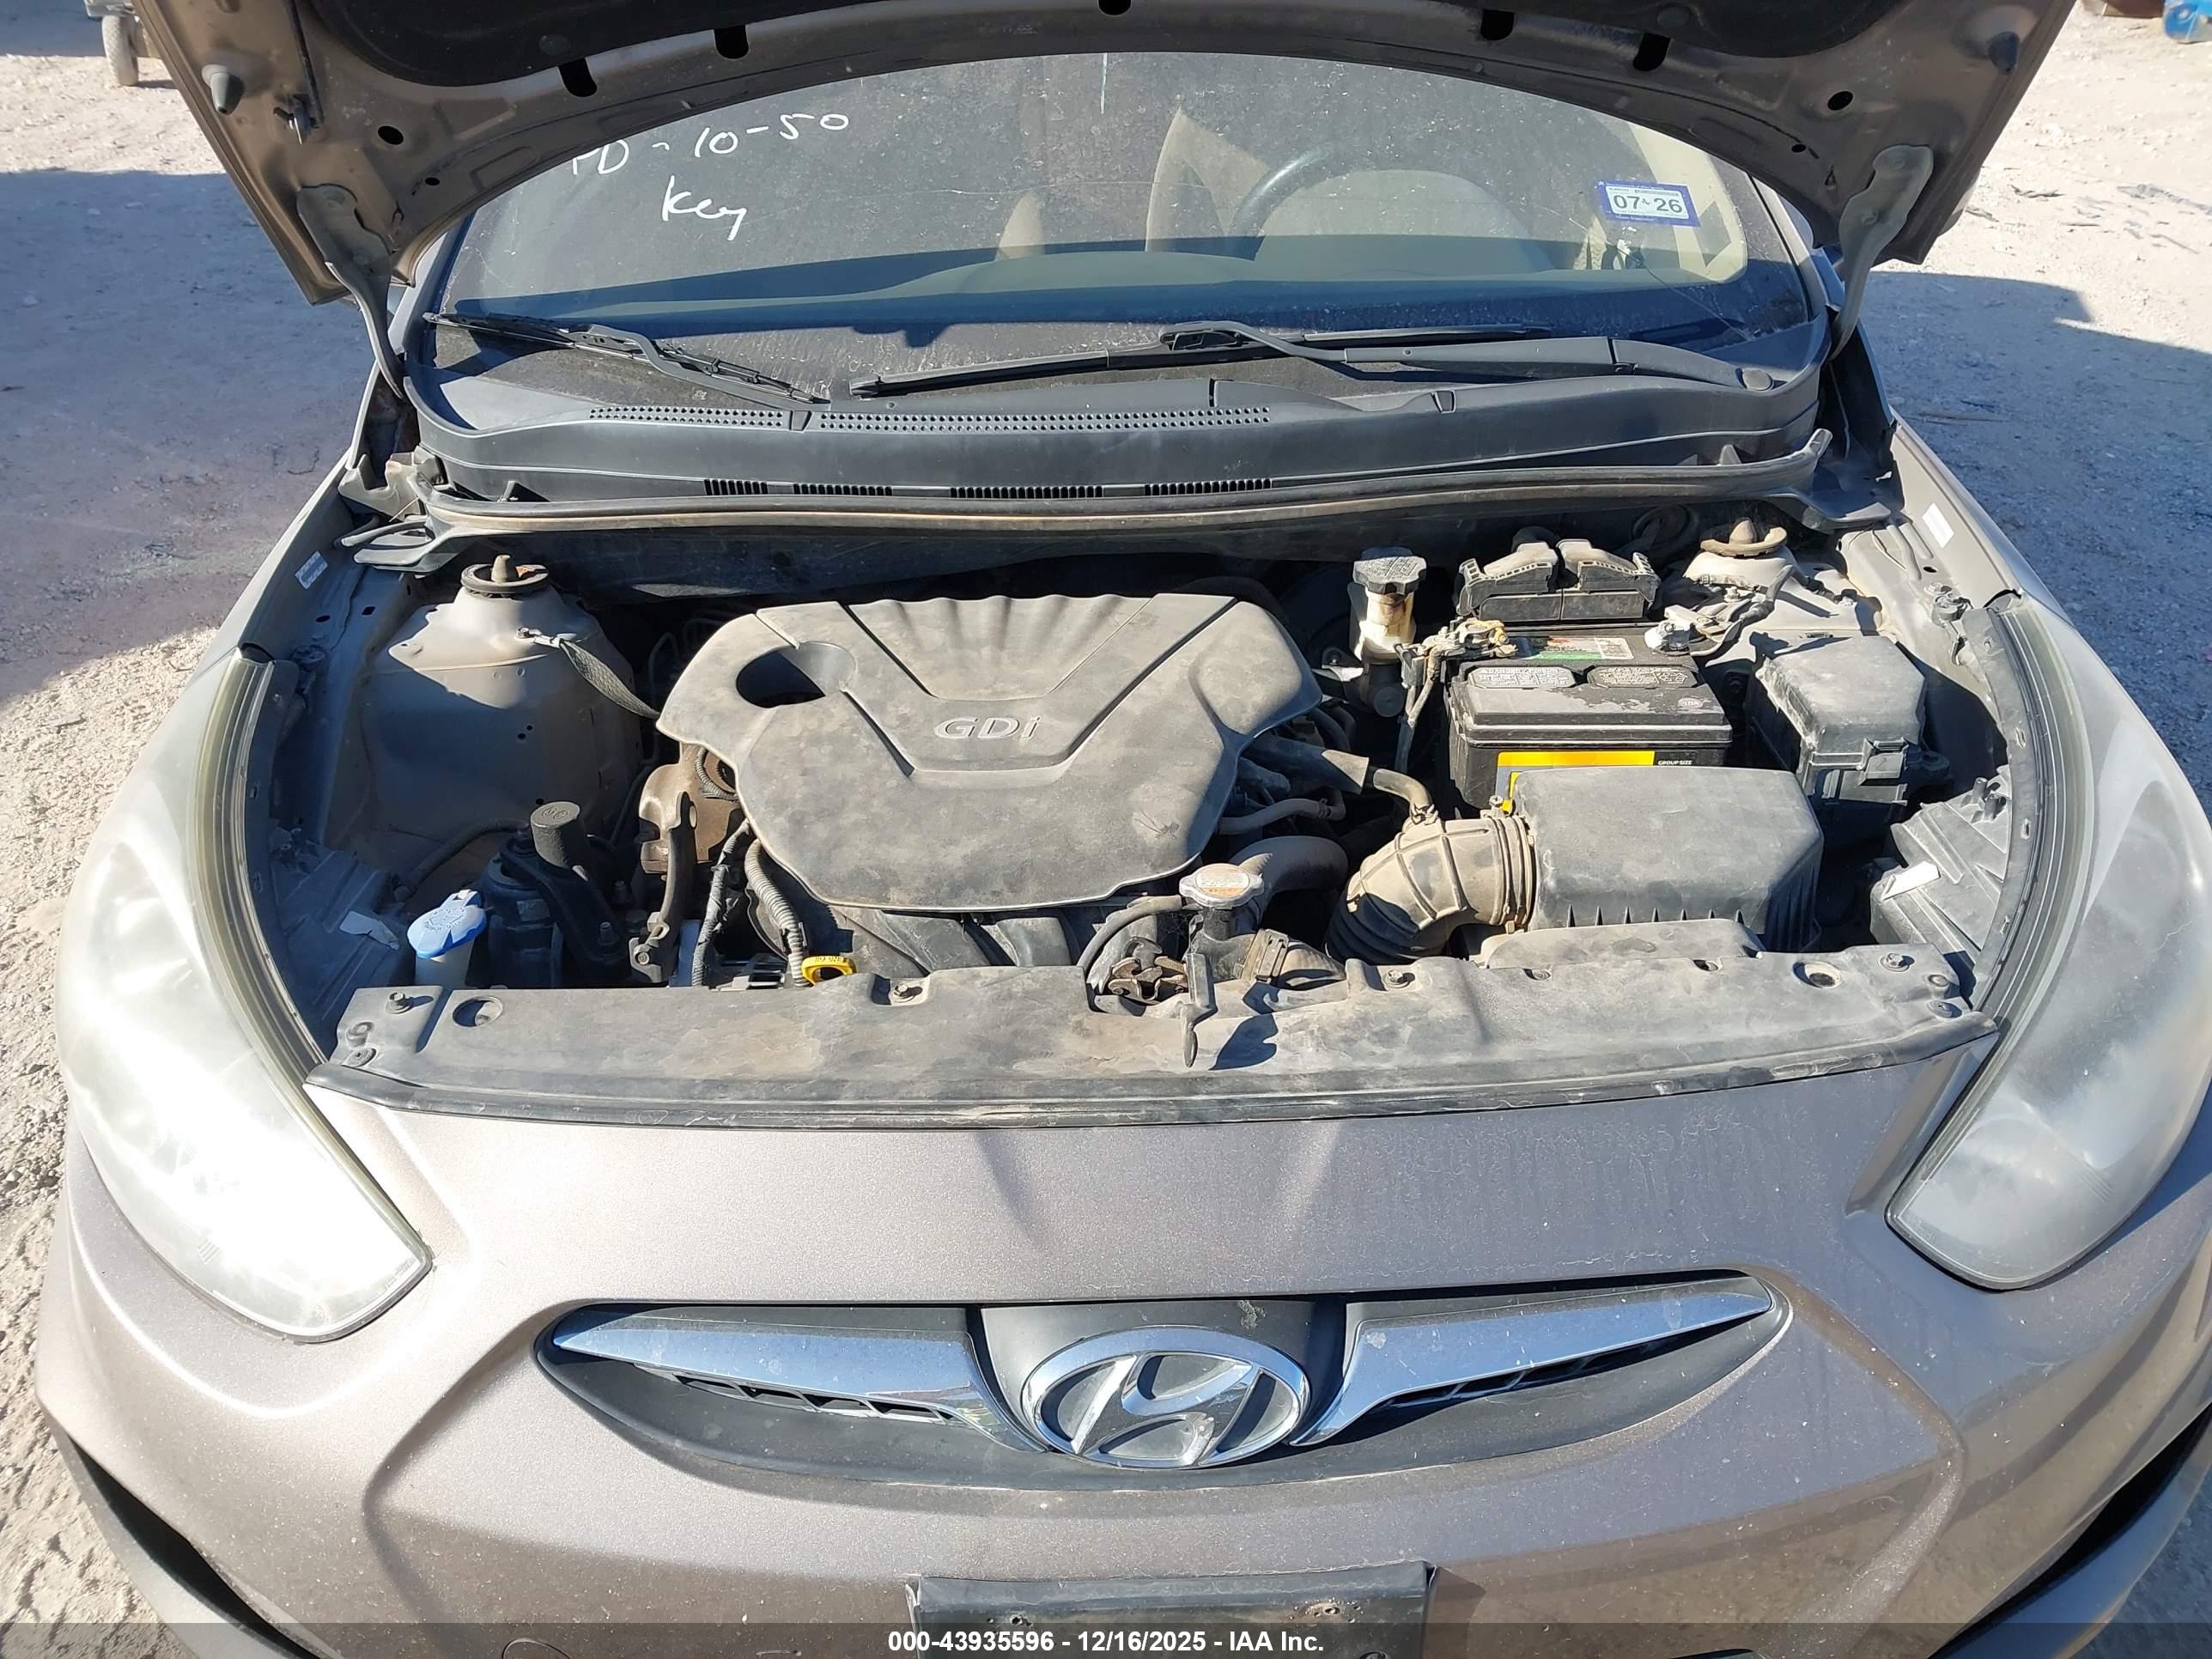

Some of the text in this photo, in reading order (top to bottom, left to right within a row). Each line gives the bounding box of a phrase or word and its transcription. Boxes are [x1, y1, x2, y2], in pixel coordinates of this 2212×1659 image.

[1613, 194, 1640, 210] 07
[1653, 197, 1683, 214] 26
[933, 715, 1041, 739] GDi
